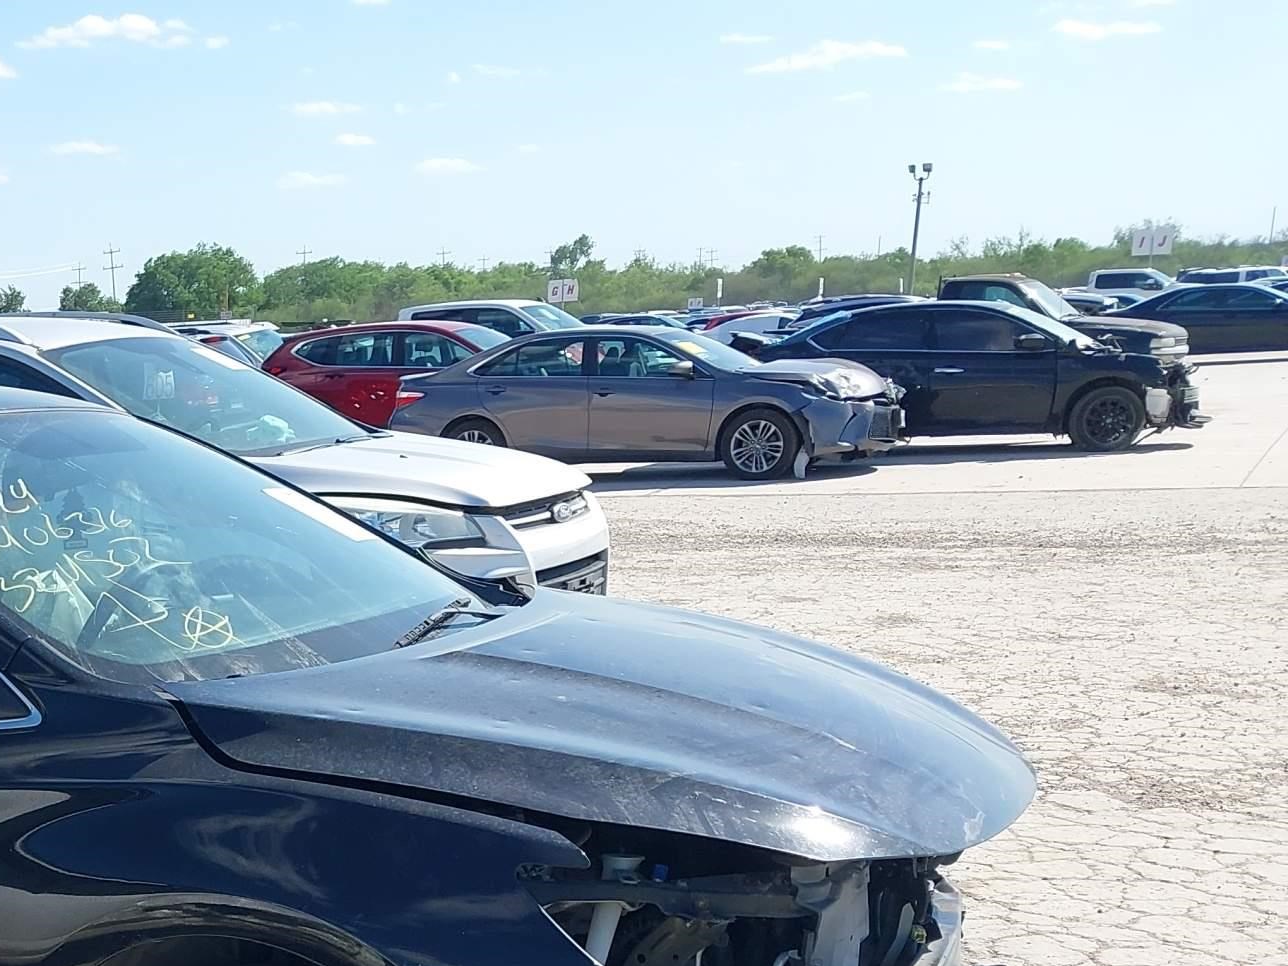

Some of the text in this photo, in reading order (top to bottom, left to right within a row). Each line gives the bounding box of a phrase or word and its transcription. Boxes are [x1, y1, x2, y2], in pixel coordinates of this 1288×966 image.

[1157, 235, 1168, 248] J
[551, 286, 559, 297] G
[567, 284, 575, 295] H
